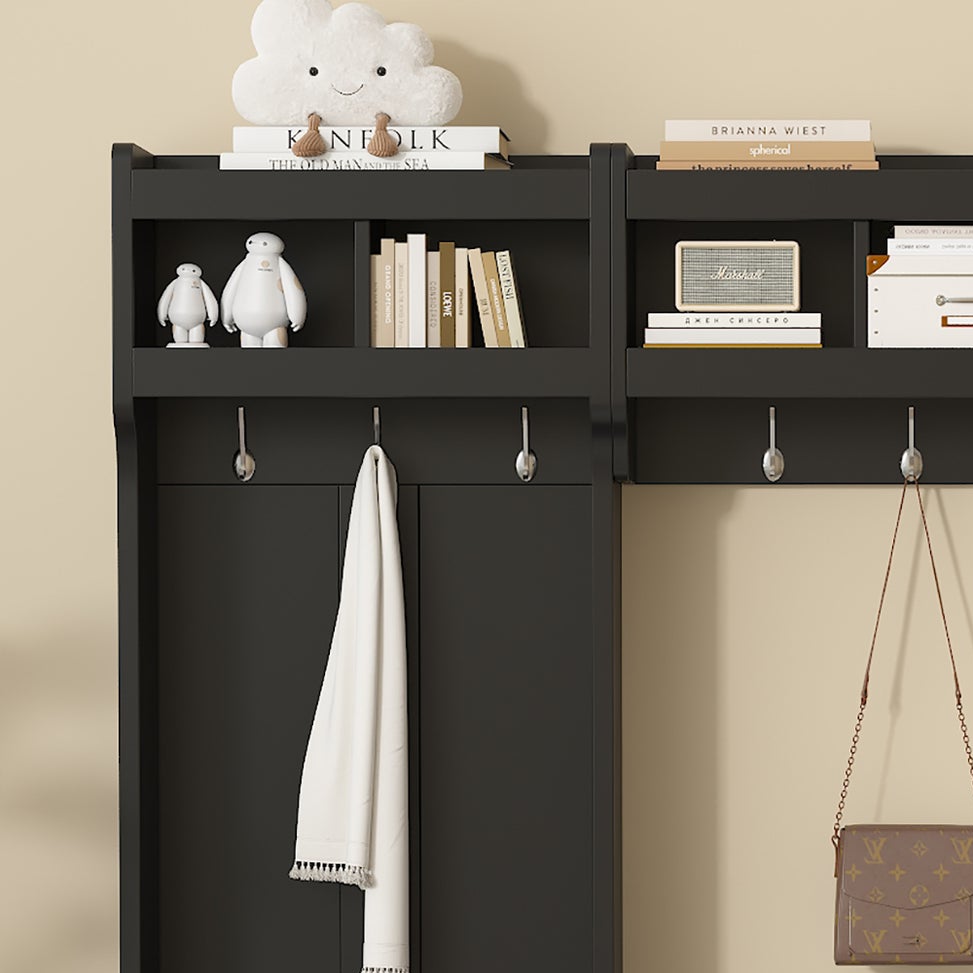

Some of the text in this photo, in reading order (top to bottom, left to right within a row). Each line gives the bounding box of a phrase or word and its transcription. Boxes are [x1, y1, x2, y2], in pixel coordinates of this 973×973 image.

[712, 126, 827, 135] BRIANNA WIEST
[288, 129, 451, 150] KNFOLK
[749, 144, 791, 157] spherical
[710, 265, 766, 280] Marshall
[443, 292, 452, 317] LOEWE
